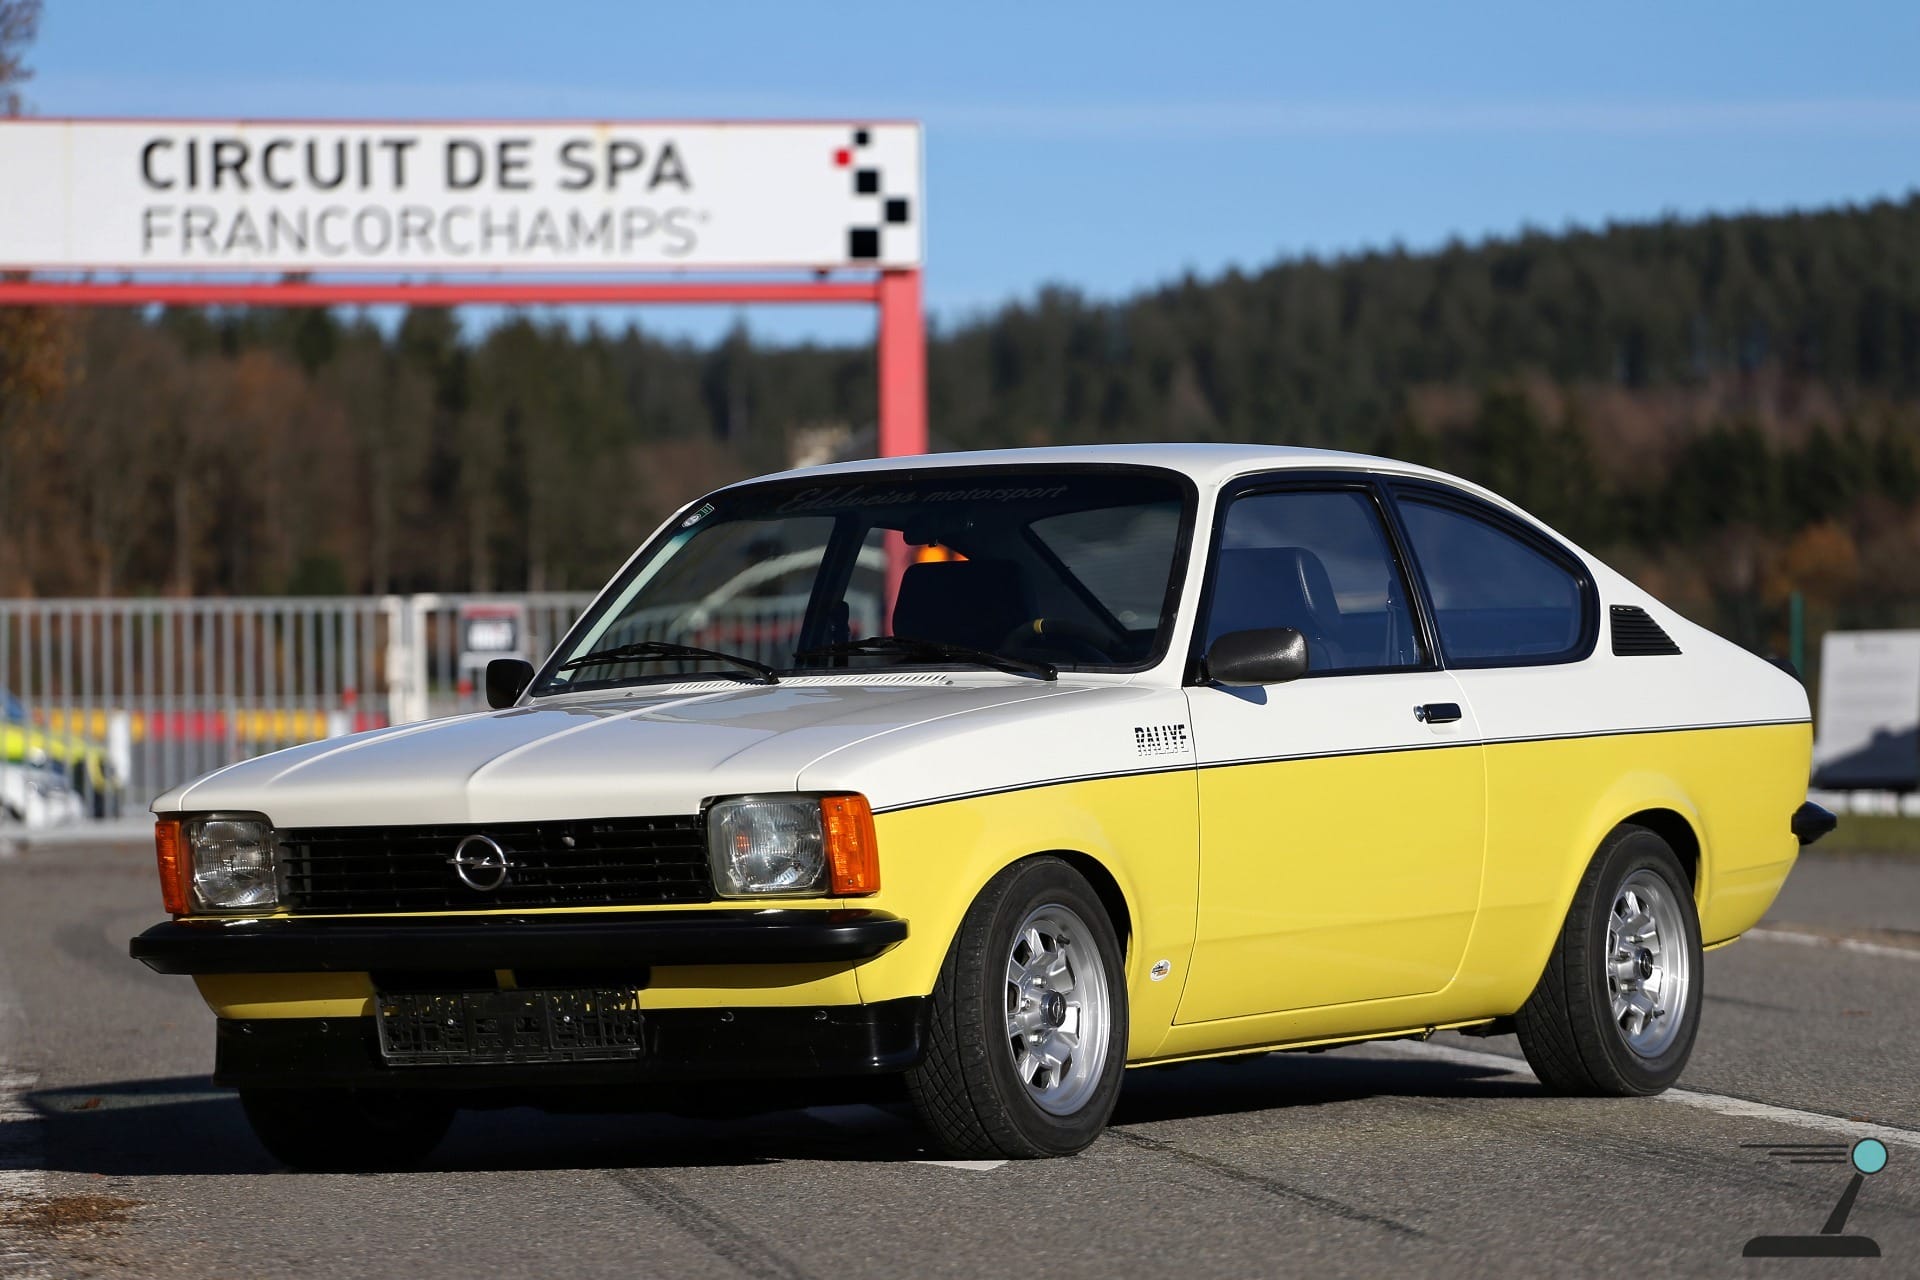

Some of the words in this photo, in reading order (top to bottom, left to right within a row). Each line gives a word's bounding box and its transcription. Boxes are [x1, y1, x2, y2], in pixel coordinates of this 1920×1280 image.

[141, 137, 418, 191] CIRCUIT
[444, 137, 533, 191] DE
[557, 137, 692, 191] SPA
[142, 204, 700, 256] FRANCORCHAMPS
[923, 484, 1069, 502] motorsport
